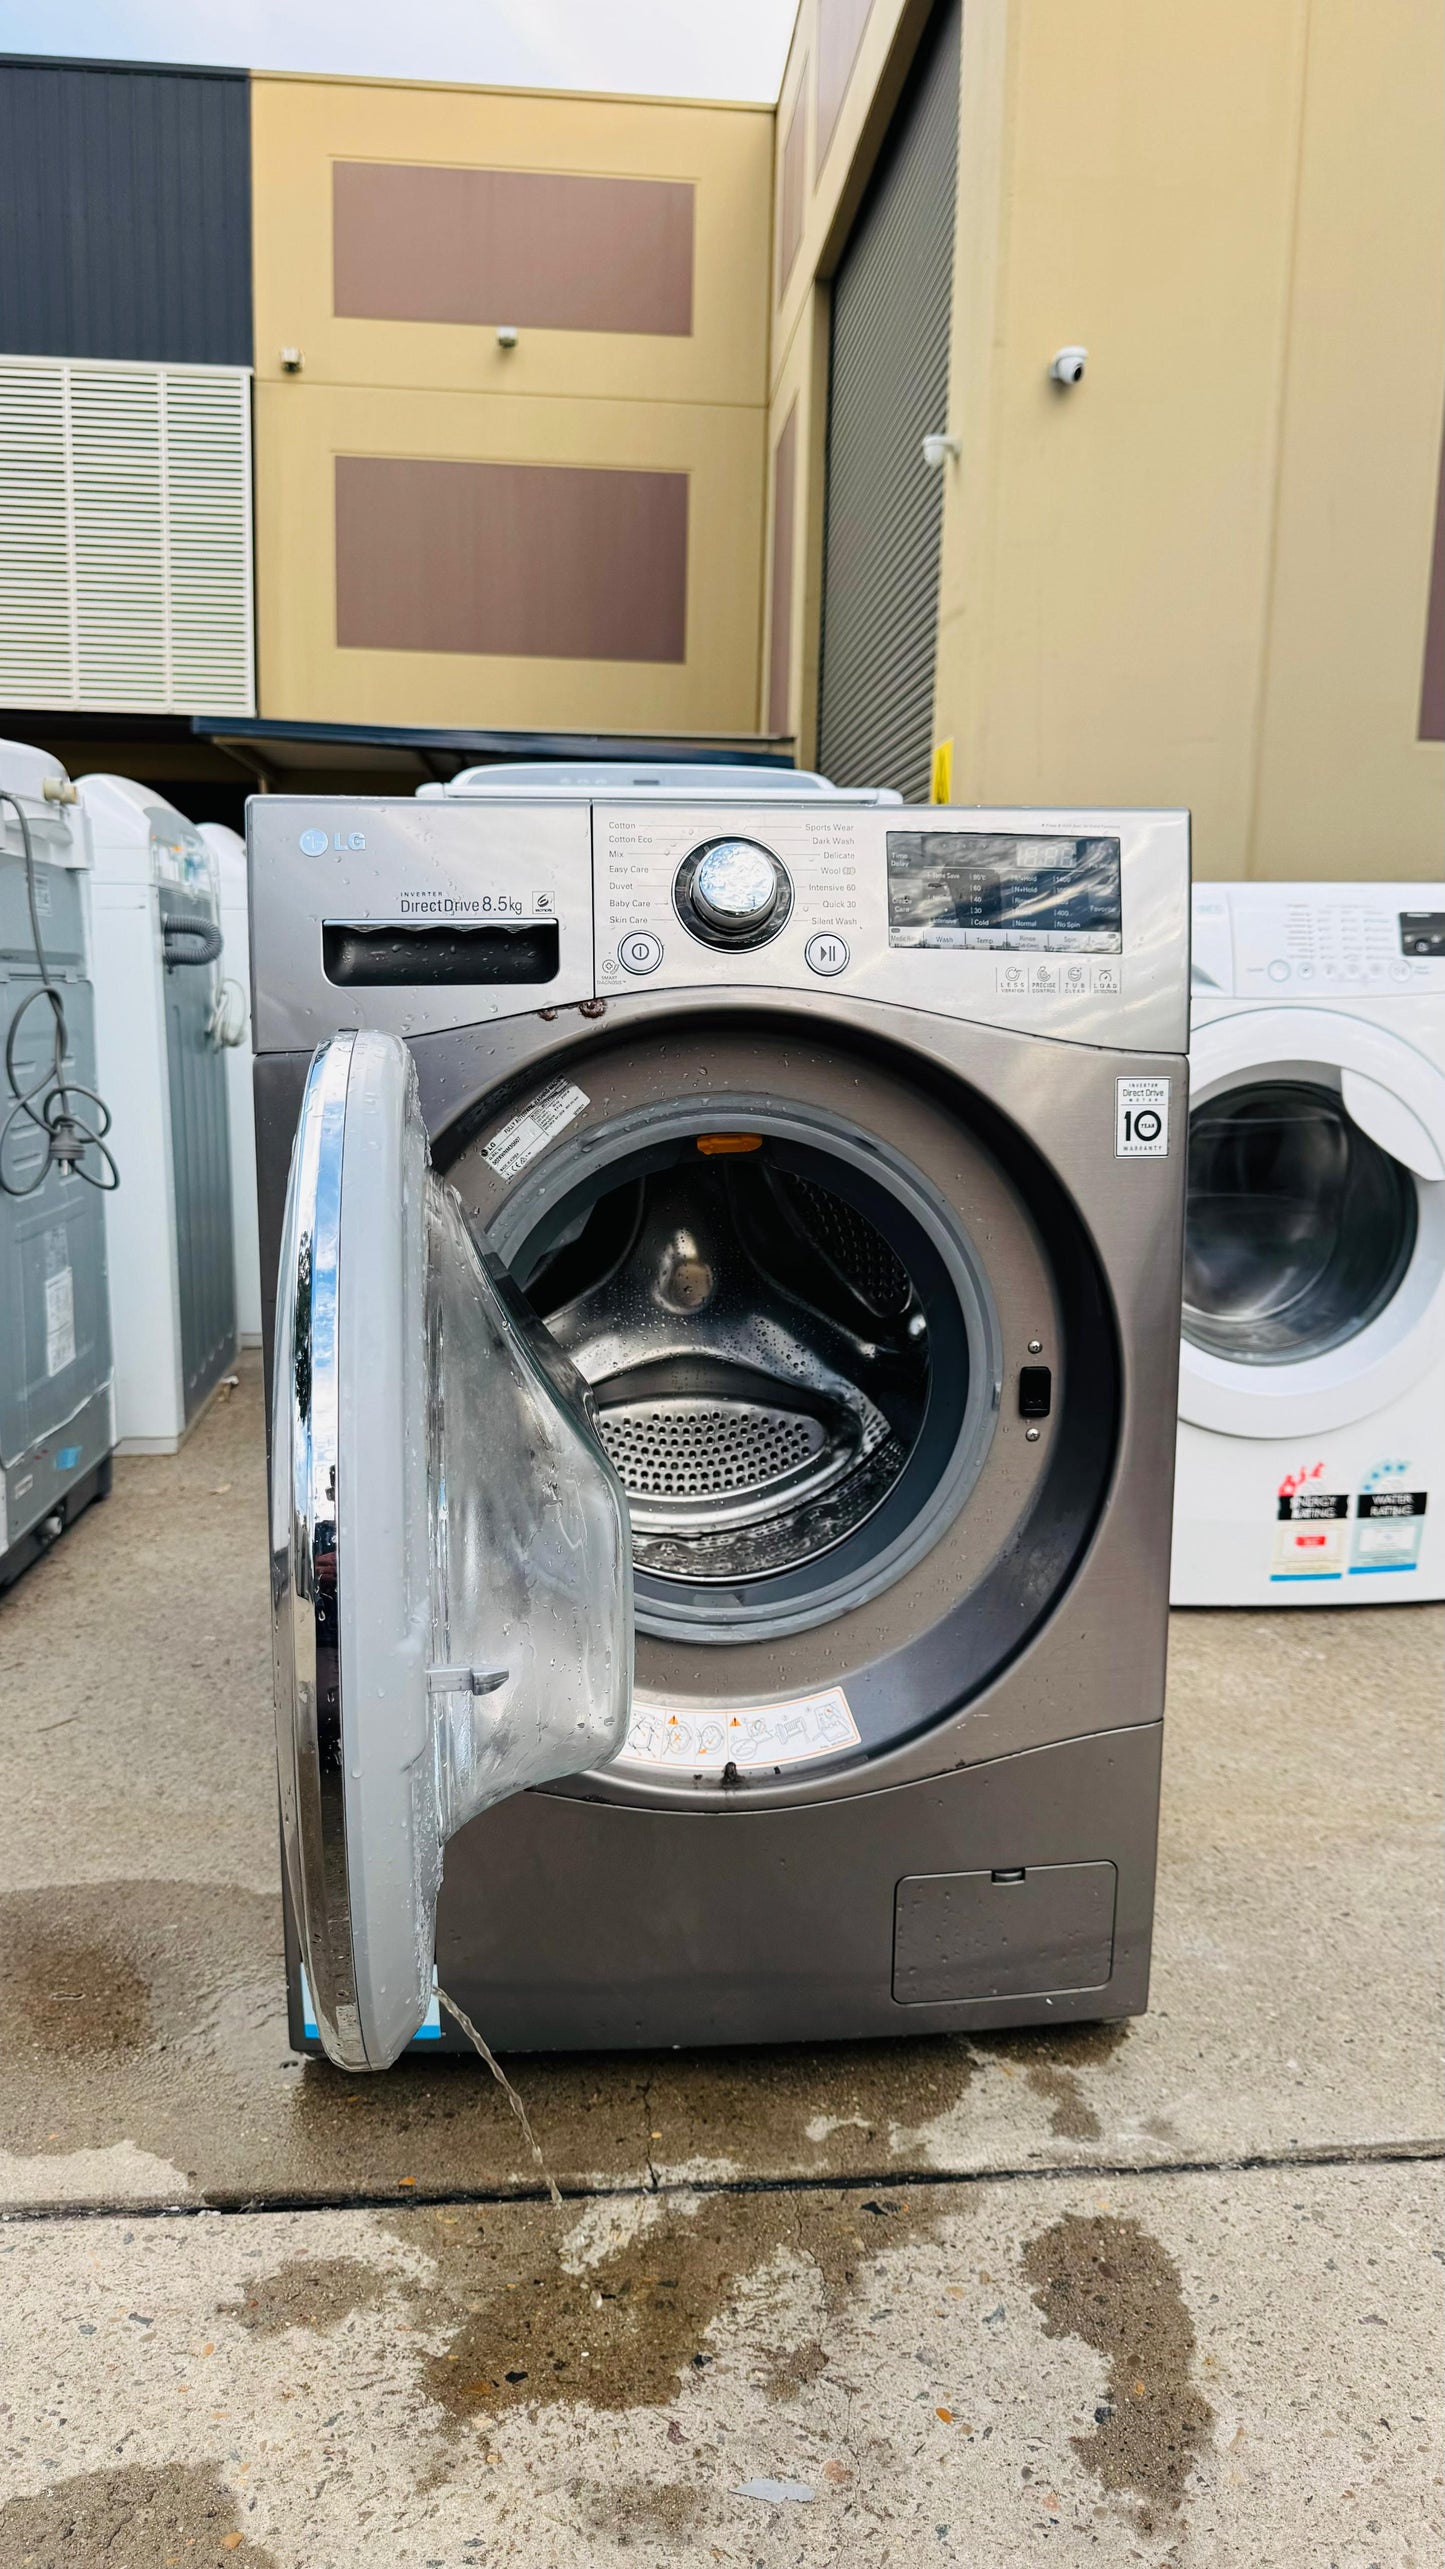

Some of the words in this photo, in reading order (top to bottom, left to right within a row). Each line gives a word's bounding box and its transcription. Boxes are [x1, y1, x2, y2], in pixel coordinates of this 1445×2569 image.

[805, 824, 831, 832] Sports
[334, 832, 366, 850] LG
[608, 850, 624, 858] Mix
[890, 860, 910, 868] Delay
[609, 866, 628, 874] Easy
[609, 882, 633, 890] Duvet
[609, 900, 630, 908] Baby
[823, 900, 845, 908] Quick
[609, 916, 627, 924] Skin
[630, 916, 648, 924] Care
[812, 917, 834, 925] Silent
[976, 937, 994, 945] Temp
[1124, 1110, 1162, 1141] 10
[486, 1141, 496, 1151] LG
[1290, 1496, 1336, 1508] ENERGY
[1372, 1494, 1413, 1505] WATER
[1291, 1508, 1336, 1518] RATING
[1370, 1506, 1414, 1516] RATING
